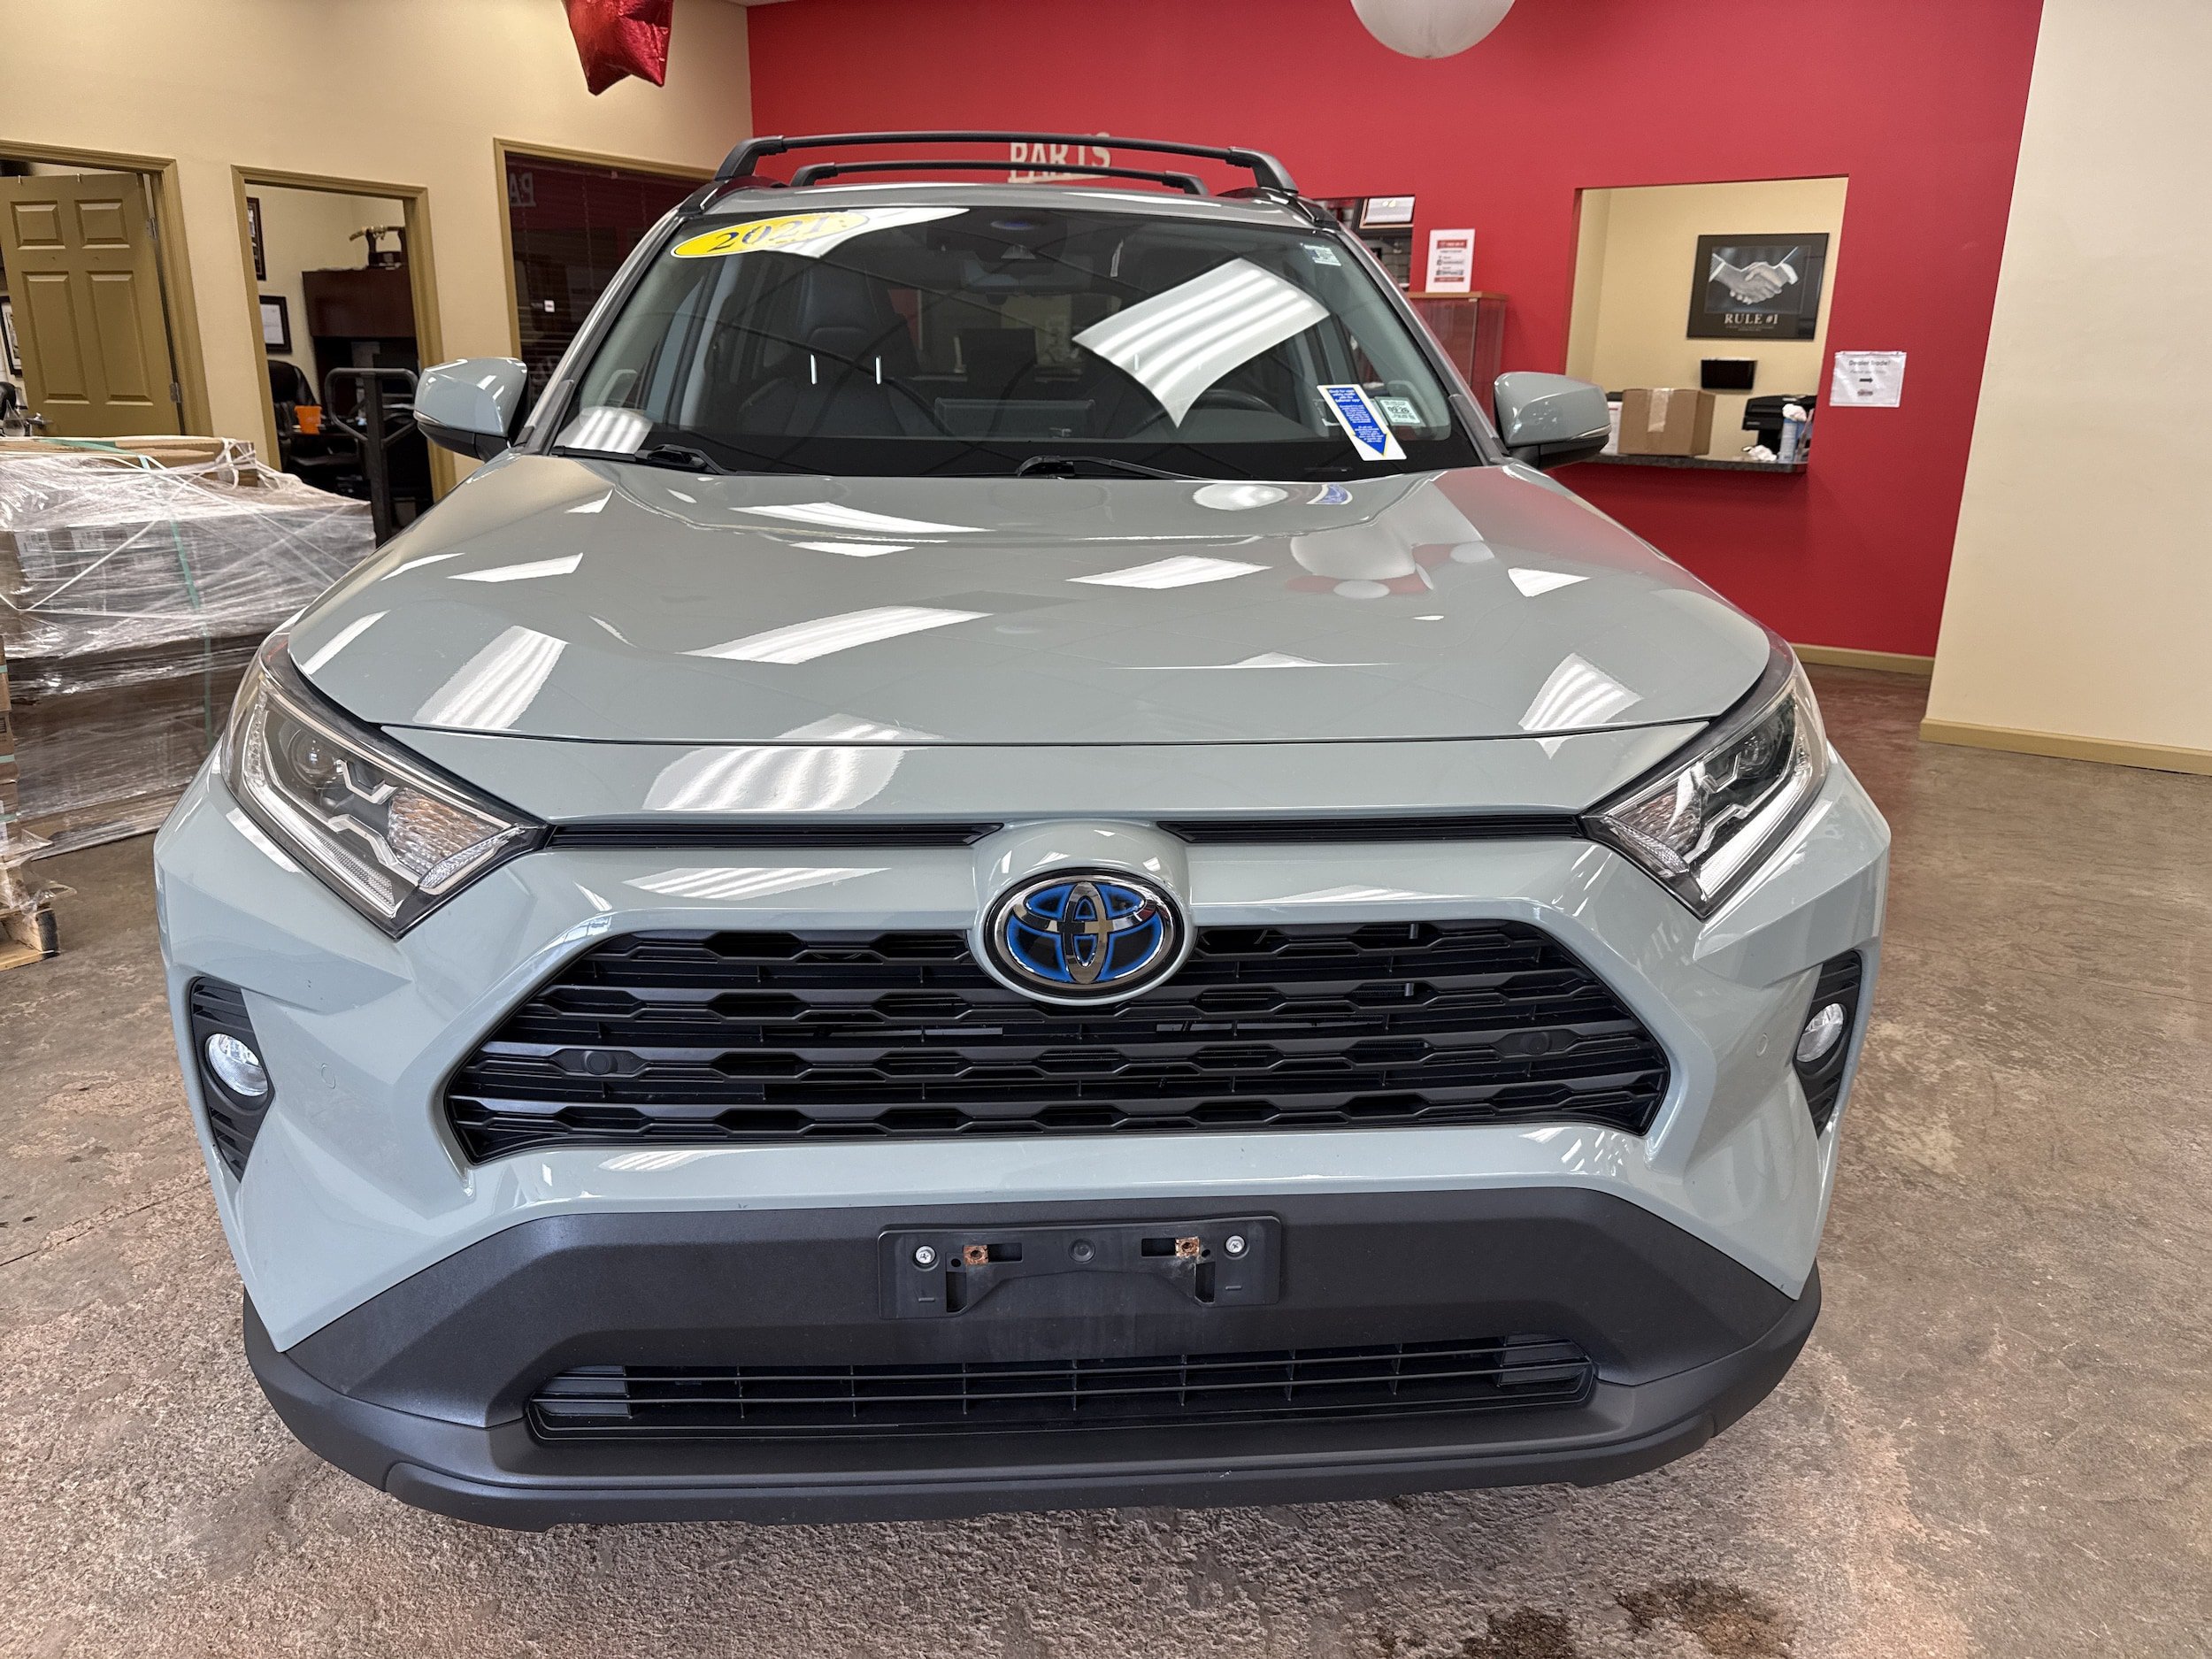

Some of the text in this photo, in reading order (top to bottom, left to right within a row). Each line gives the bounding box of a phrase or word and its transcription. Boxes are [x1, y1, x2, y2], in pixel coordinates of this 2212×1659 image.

[707, 215, 831, 253] 2021
[1724, 313, 1778, 325] RULE #1
